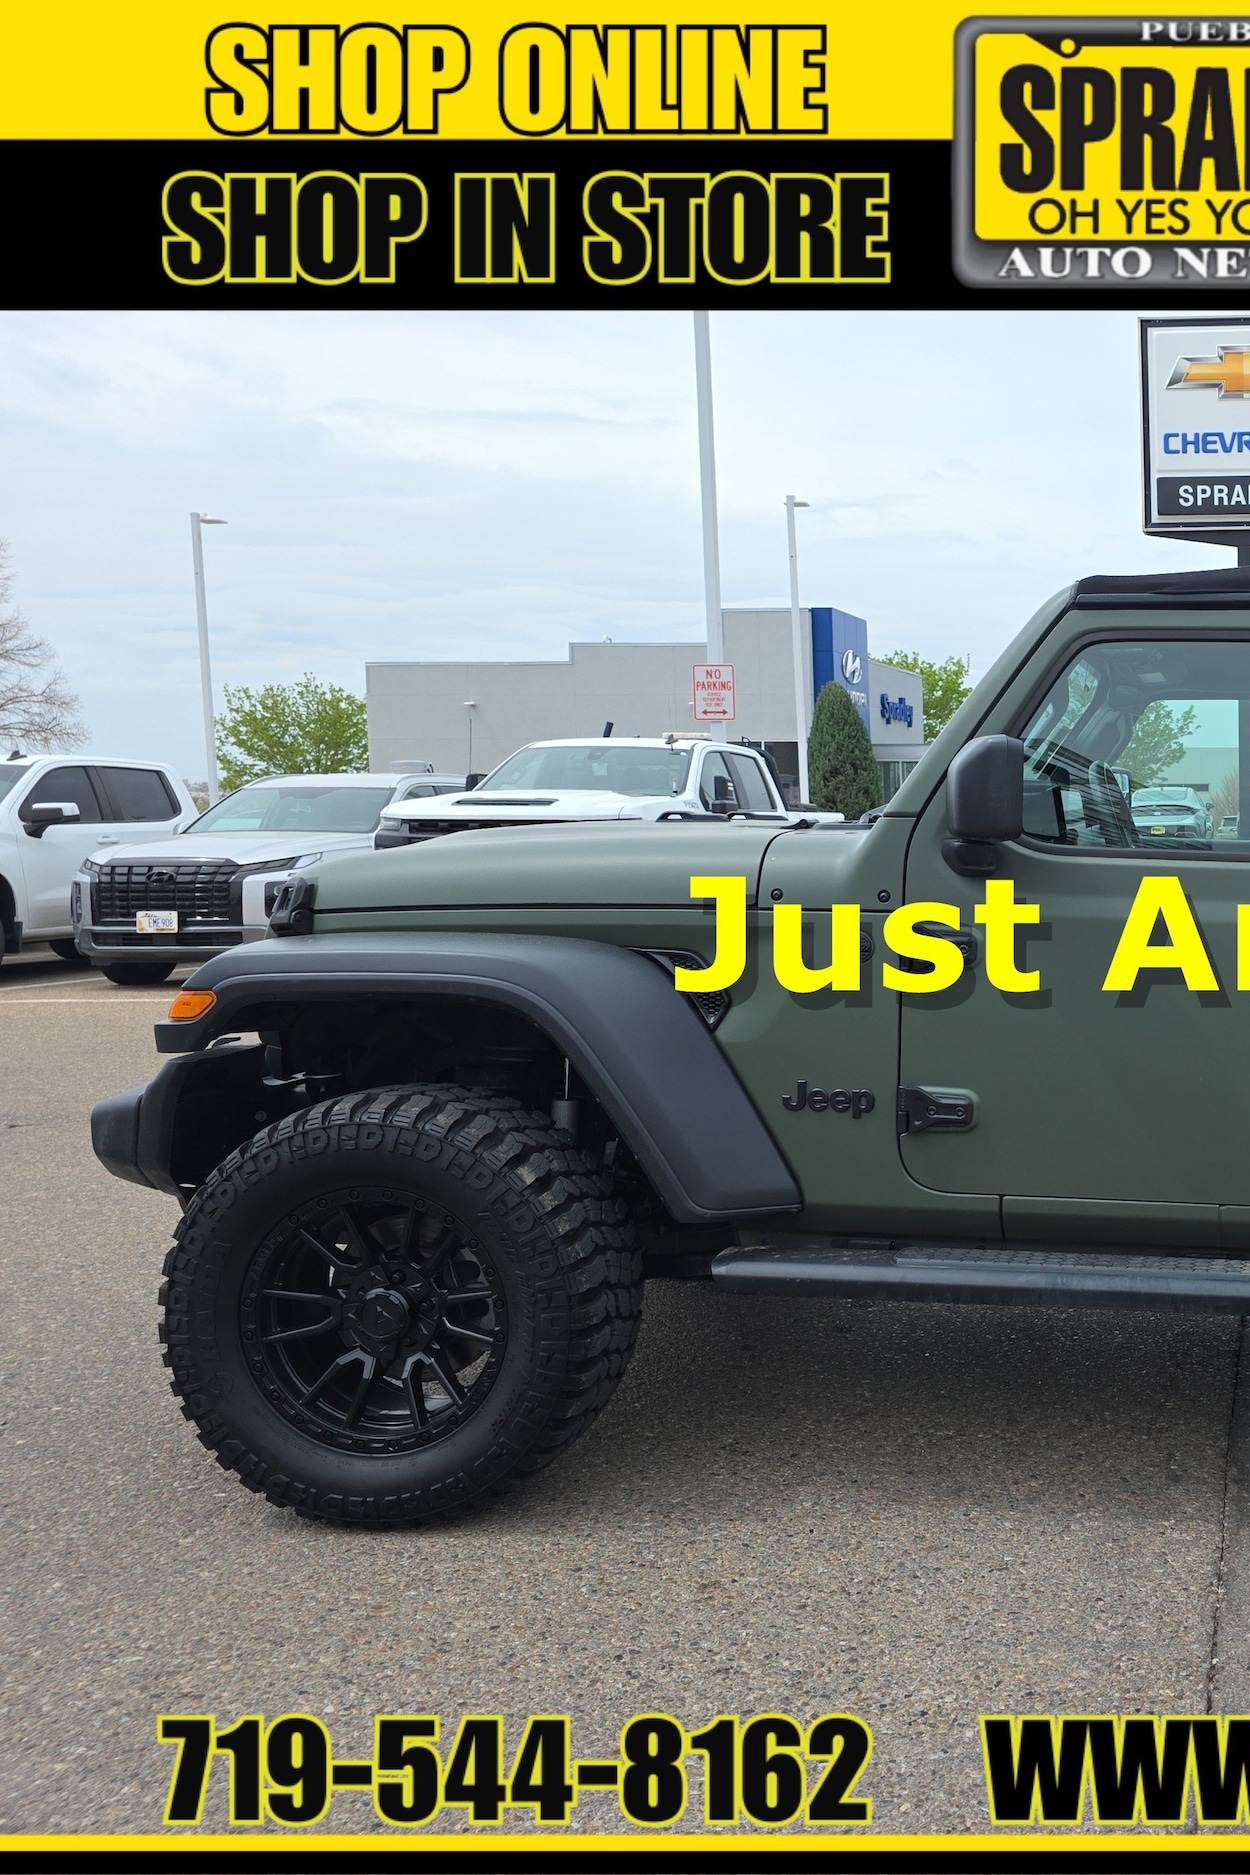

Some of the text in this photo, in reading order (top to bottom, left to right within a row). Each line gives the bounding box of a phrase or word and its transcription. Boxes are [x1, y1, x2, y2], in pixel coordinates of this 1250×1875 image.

[696, 680, 732, 692] PARKING
[706, 669, 721, 680] NO
[881, 693, 914, 728] Spradley
[782, 1079, 875, 1119] Jeep
